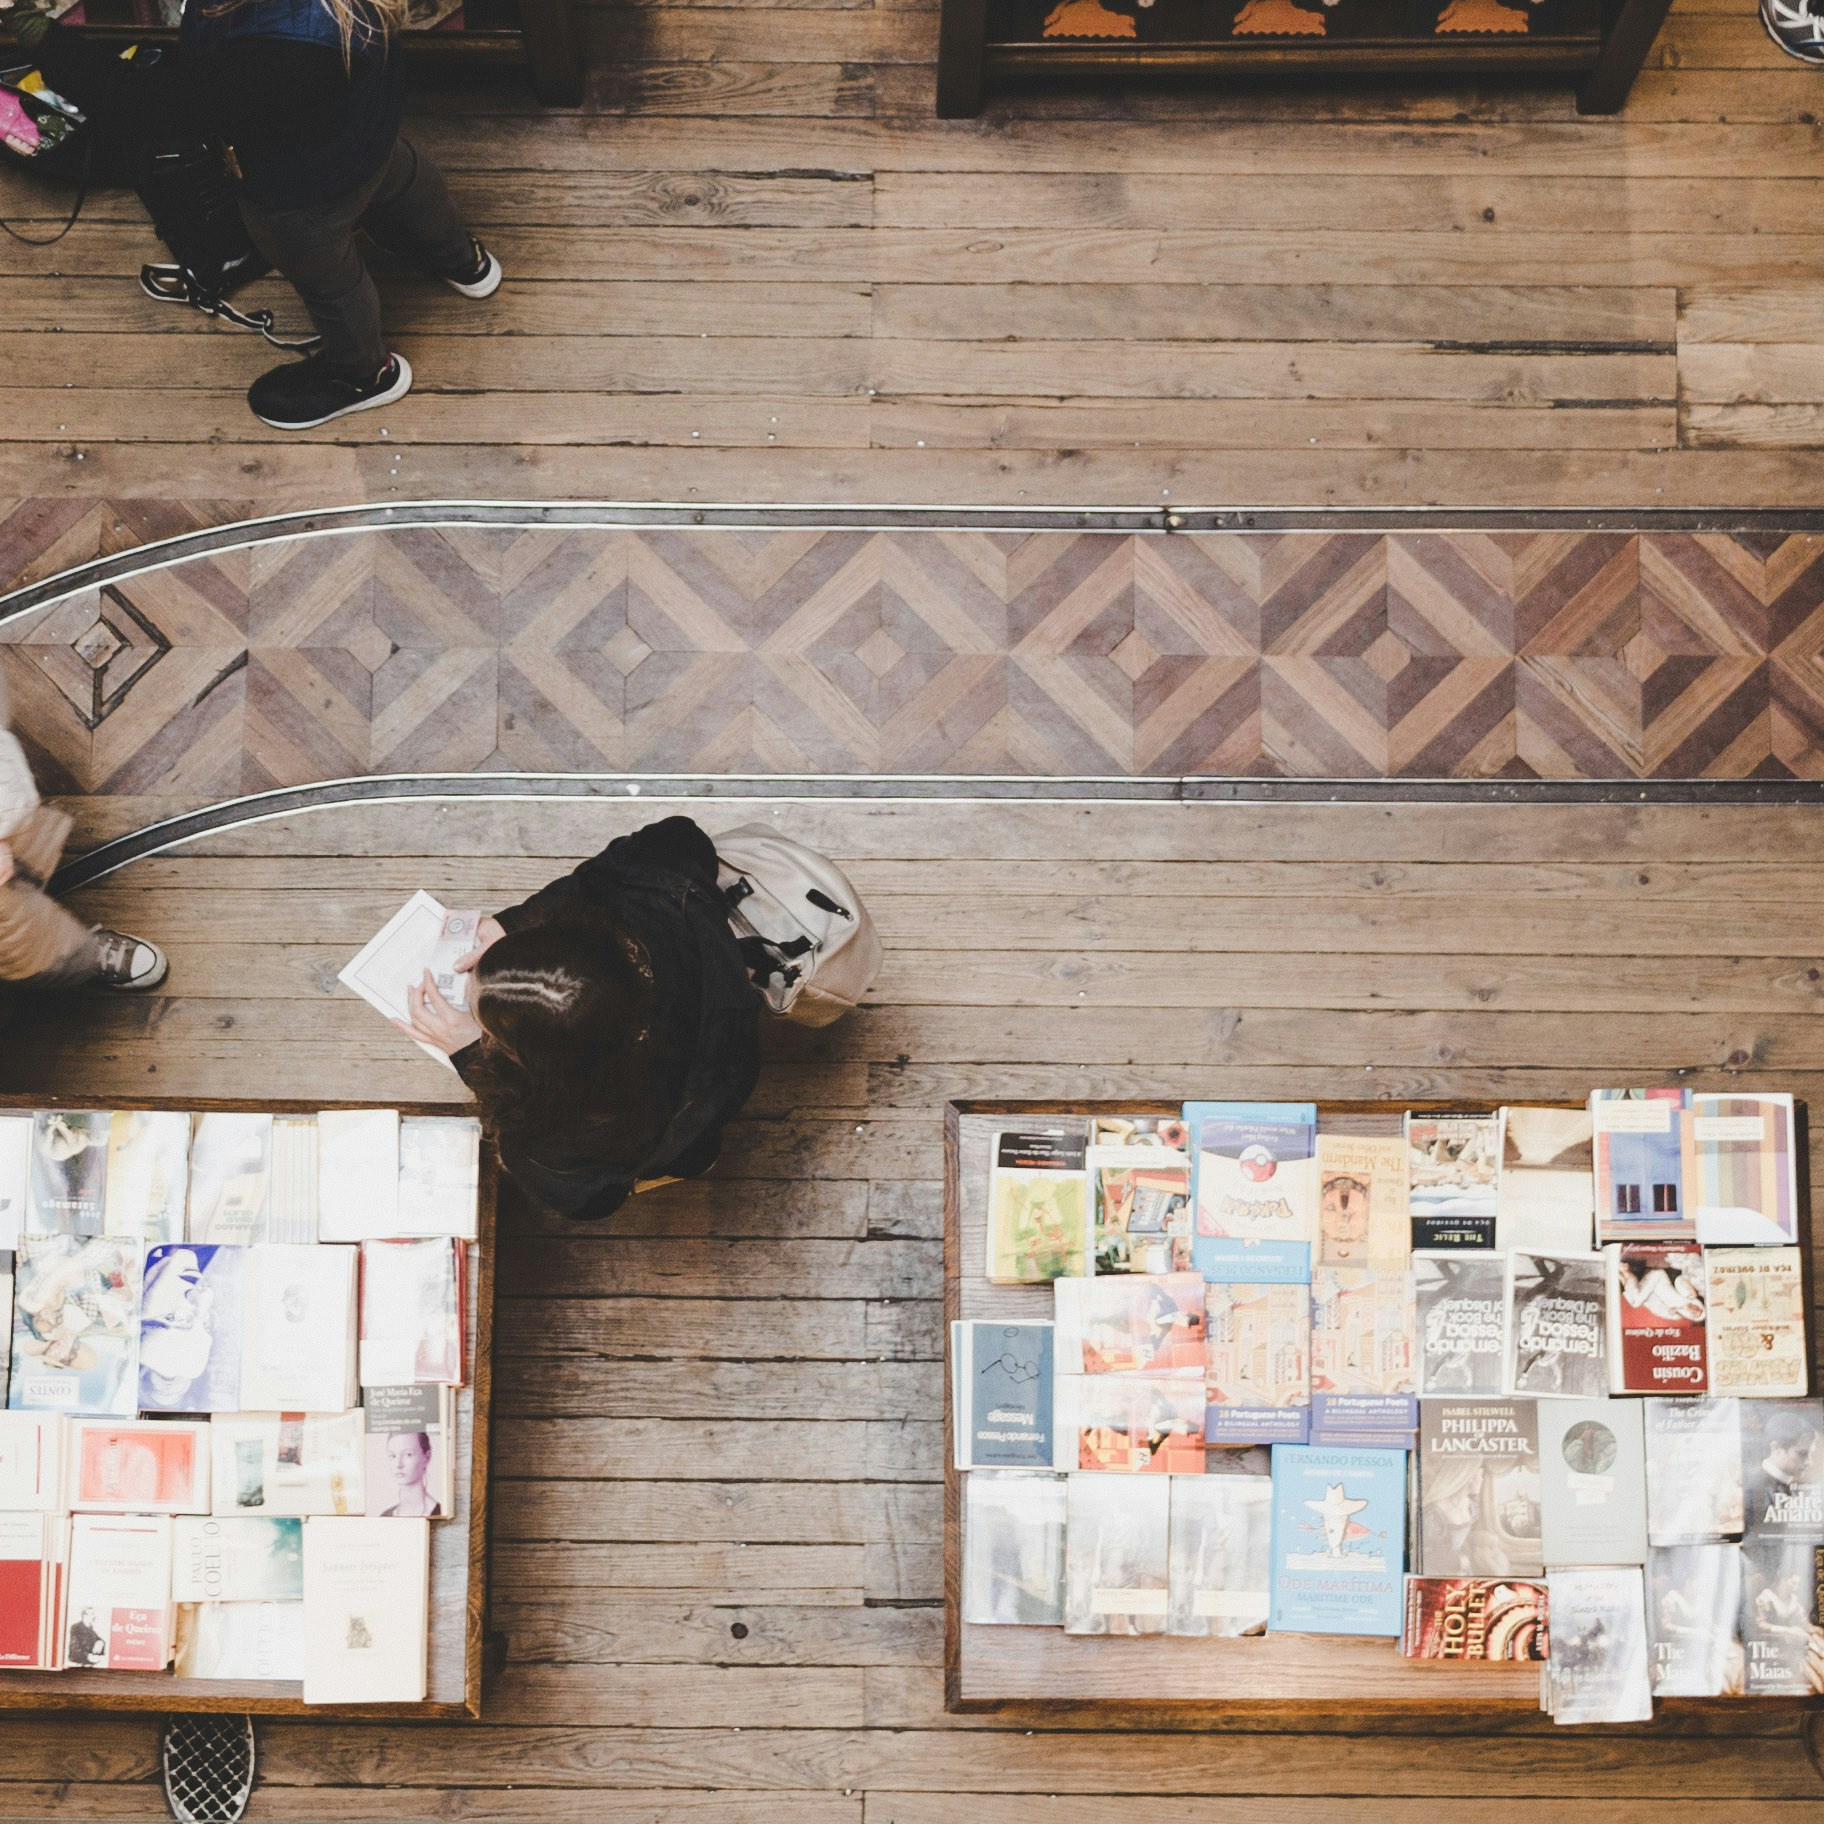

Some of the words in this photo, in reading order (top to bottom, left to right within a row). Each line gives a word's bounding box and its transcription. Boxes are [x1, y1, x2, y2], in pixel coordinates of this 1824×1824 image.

[1378, 1155, 1403, 1171] The
[1221, 1194, 1294, 1221] Pokémon
[1537, 1323, 1598, 1341] Pessoa
[1520, 1337, 1597, 1356] Fernando
[1652, 1344, 1701, 1360] Bazilio
[1652, 1366, 1702, 1383] Cousin
[29, 1384, 71, 1396] CONTES
[1338, 1396, 1383, 1408] Portuguese
[1384, 1397, 1409, 1407] Poets
[988, 1410, 1034, 1425] Message
[1231, 1409, 1276, 1420] Portuguese
[1278, 1410, 1301, 1419] Poets
[1441, 1419, 1517, 1434] PHILIPPA
[1431, 1436, 1535, 1454] LANCASTER
[1350, 1455, 1394, 1468] PESSOA
[1775, 1491, 1823, 1510] Padre
[1763, 1506, 1823, 1524] Amaro
[204, 1521, 222, 1598] COELHO
[1442, 1583, 1466, 1657] HOLY
[1465, 1582, 1486, 1657] BULLET
[1748, 1641, 1778, 1659] The
[1749, 1661, 1793, 1679] Maias
